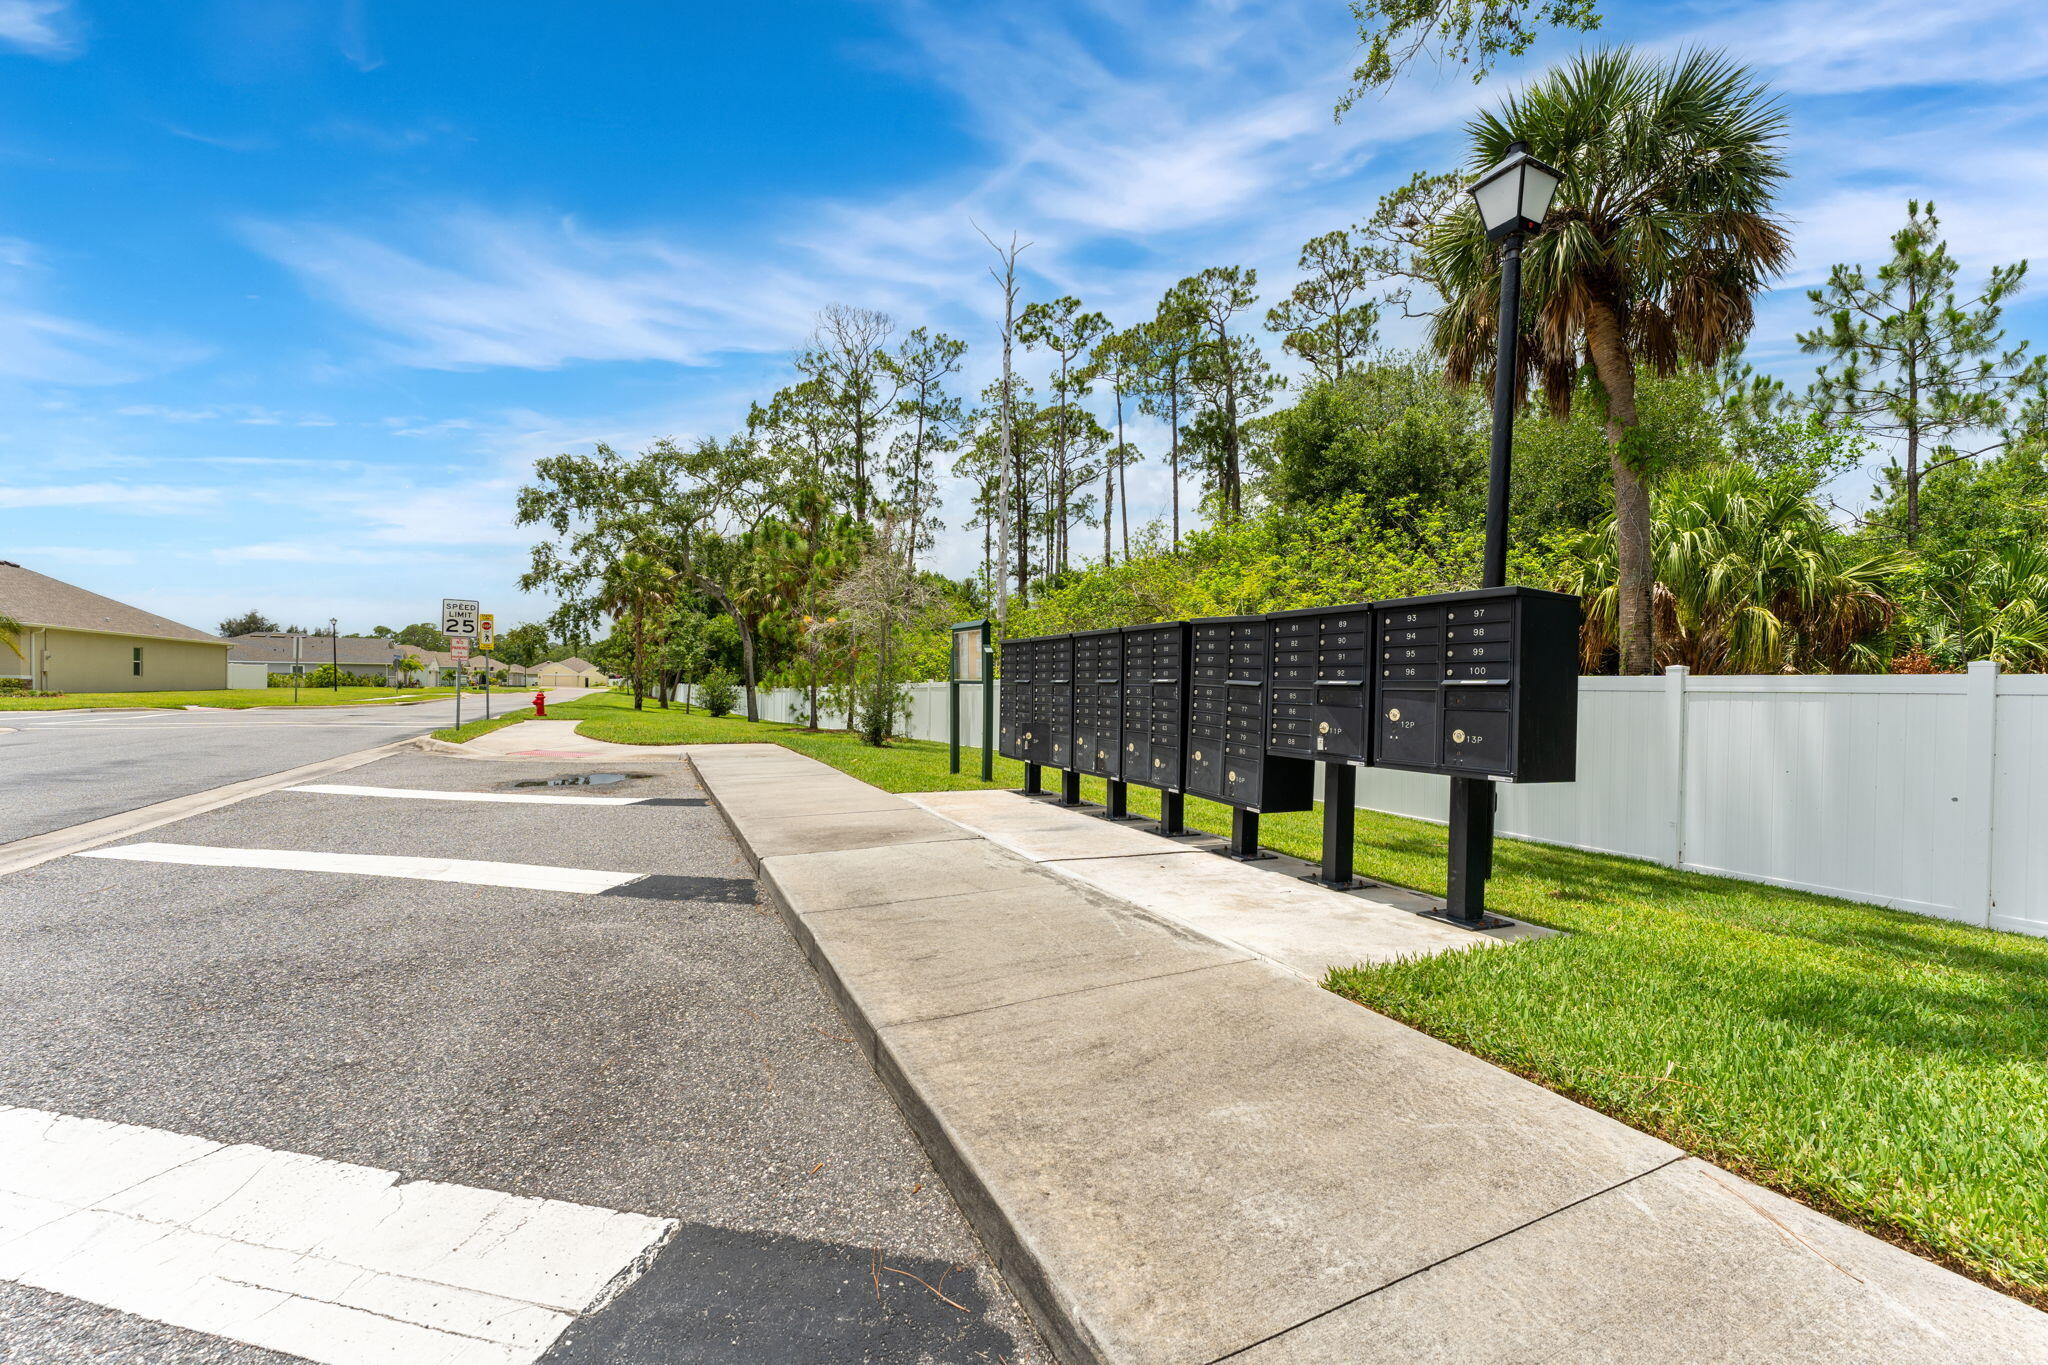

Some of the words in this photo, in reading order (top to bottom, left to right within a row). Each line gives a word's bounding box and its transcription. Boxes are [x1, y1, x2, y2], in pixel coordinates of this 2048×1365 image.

[446, 603, 476, 611] SPEED
[1474, 609, 1485, 617] 97
[446, 619, 475, 633] 25
[1338, 620, 1347, 628] 89
[1473, 628, 1484, 636] 98
[1406, 650, 1416, 658] 95
[1472, 648, 1484, 656] 99
[1337, 669, 1345, 677] 92
[1405, 668, 1415, 676] 96
[1470, 667, 1486, 675] 100
[1289, 692, 1297, 700] 85
[1401, 721, 1415, 729] 12P
